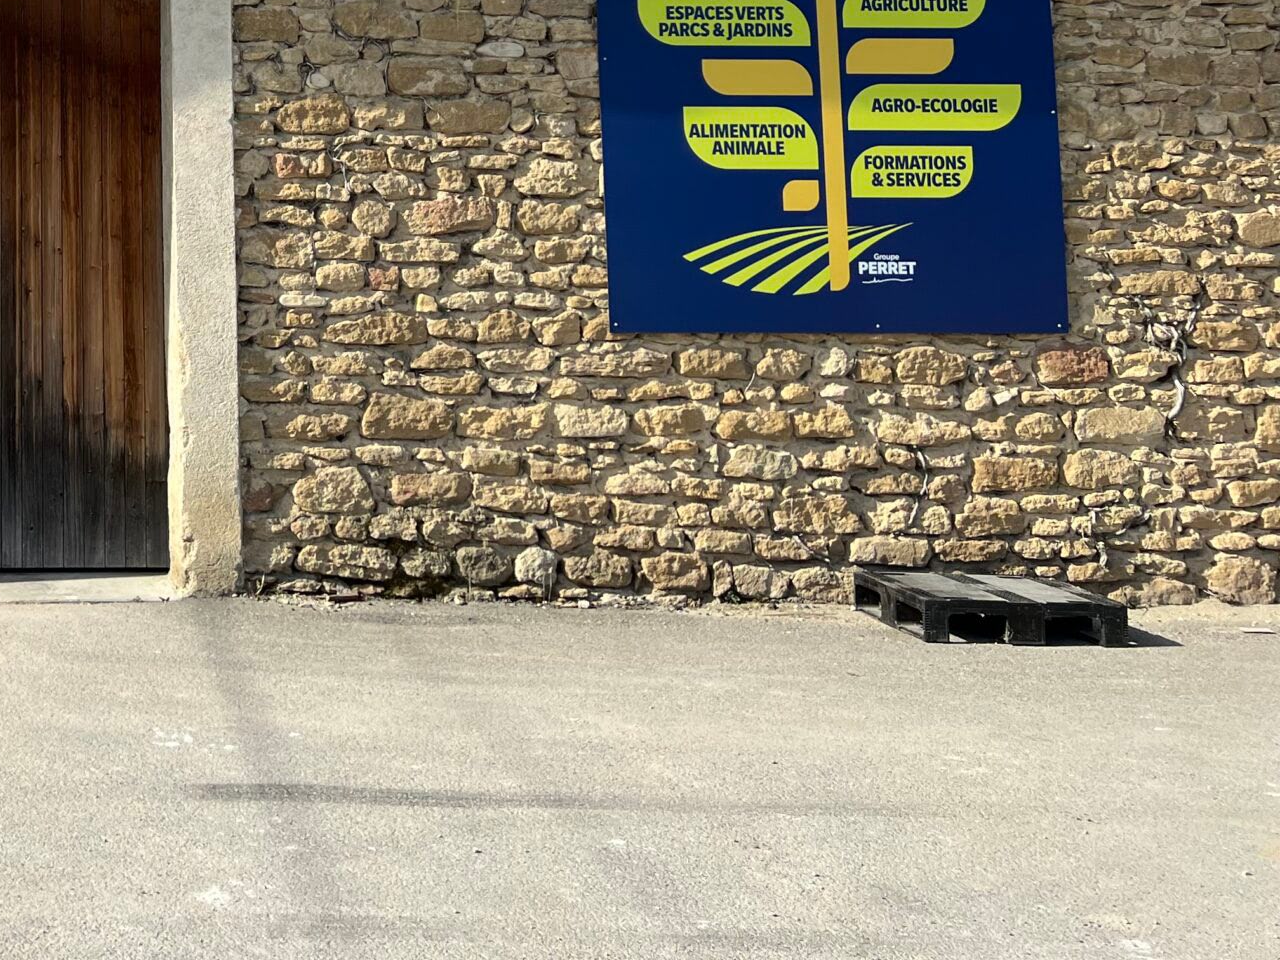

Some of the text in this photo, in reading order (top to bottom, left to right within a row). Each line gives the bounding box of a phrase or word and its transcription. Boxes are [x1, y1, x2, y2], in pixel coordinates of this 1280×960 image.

[665, 5, 784, 21] ESPACES VERTS
[659, 22, 793, 41] PARCS & JARDINS
[871, 98, 998, 113] AGRO-ECOLOGIE
[689, 123, 806, 139] ALIMENTATION
[712, 140, 785, 156] ANIMALE
[864, 155, 967, 170] FORMATIONS
[871, 172, 961, 187] & SERVICES
[873, 252, 900, 261] Groupe
[858, 261, 917, 275] PERRET
